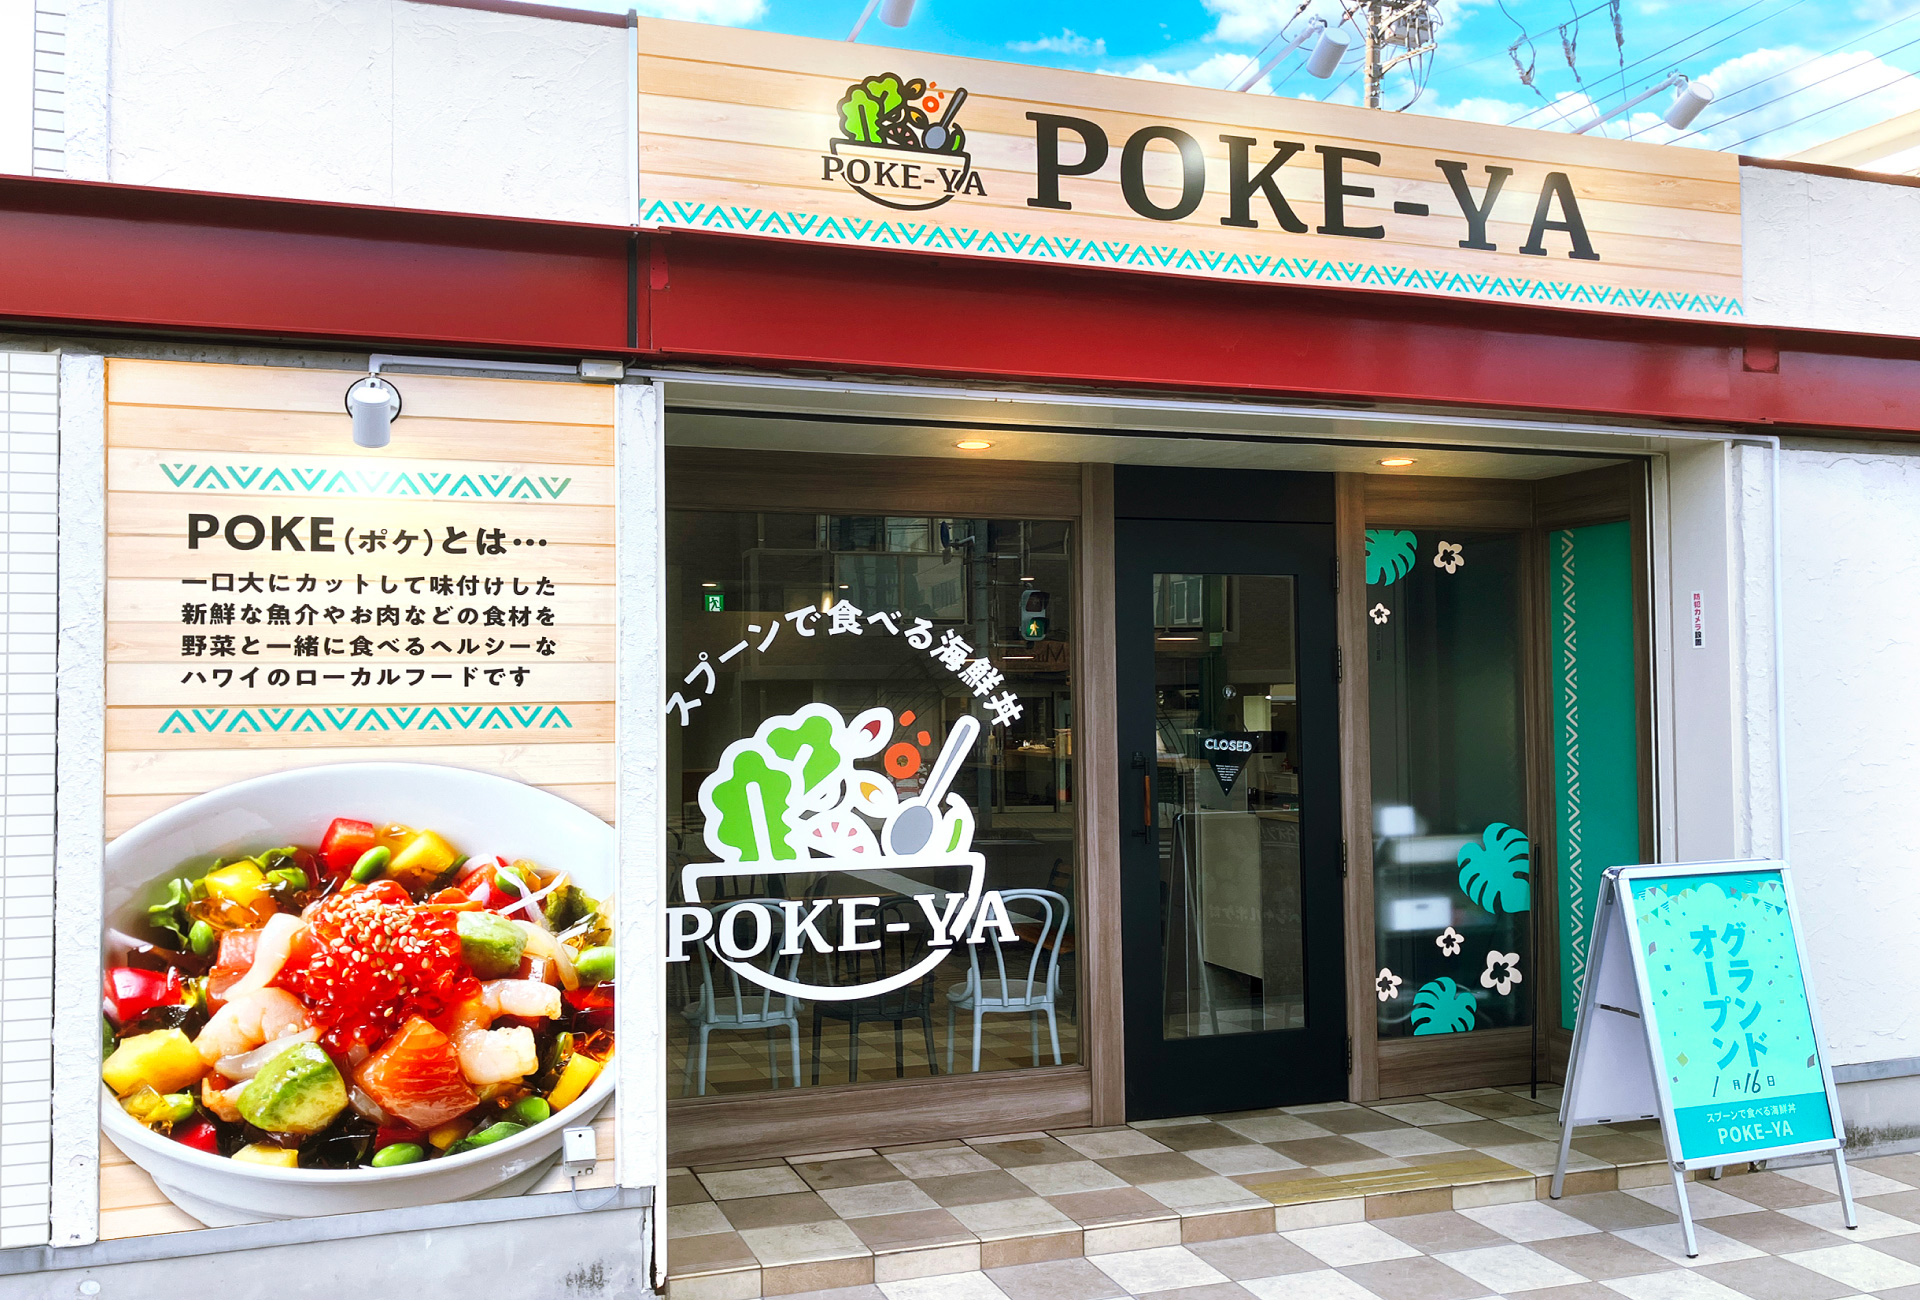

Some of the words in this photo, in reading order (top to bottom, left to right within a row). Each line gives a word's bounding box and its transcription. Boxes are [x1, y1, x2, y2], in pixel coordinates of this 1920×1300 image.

[822, 155, 988, 198] POKE-YA
[1027, 111, 1600, 261] POKE-YA
[181, 571, 556, 597] 一口大にカットして味付けした
[181, 602, 556, 627] 新鮮な魚介やお肉などの食材を
[181, 634, 556, 658] 野菜と一緒に食べるヘルシーな
[181, 666, 532, 689] ハワイのローカルフードです
[666, 599, 1026, 728] スプーンで食べる海鮮丼
[1204, 738, 1253, 752] CLOSED
[666, 890, 1020, 963] POKE-YA
[1689, 924, 1739, 1071] オープン
[1720, 921, 1769, 1068] グランド
[1717, 1119, 1794, 1145] POKE-YA
